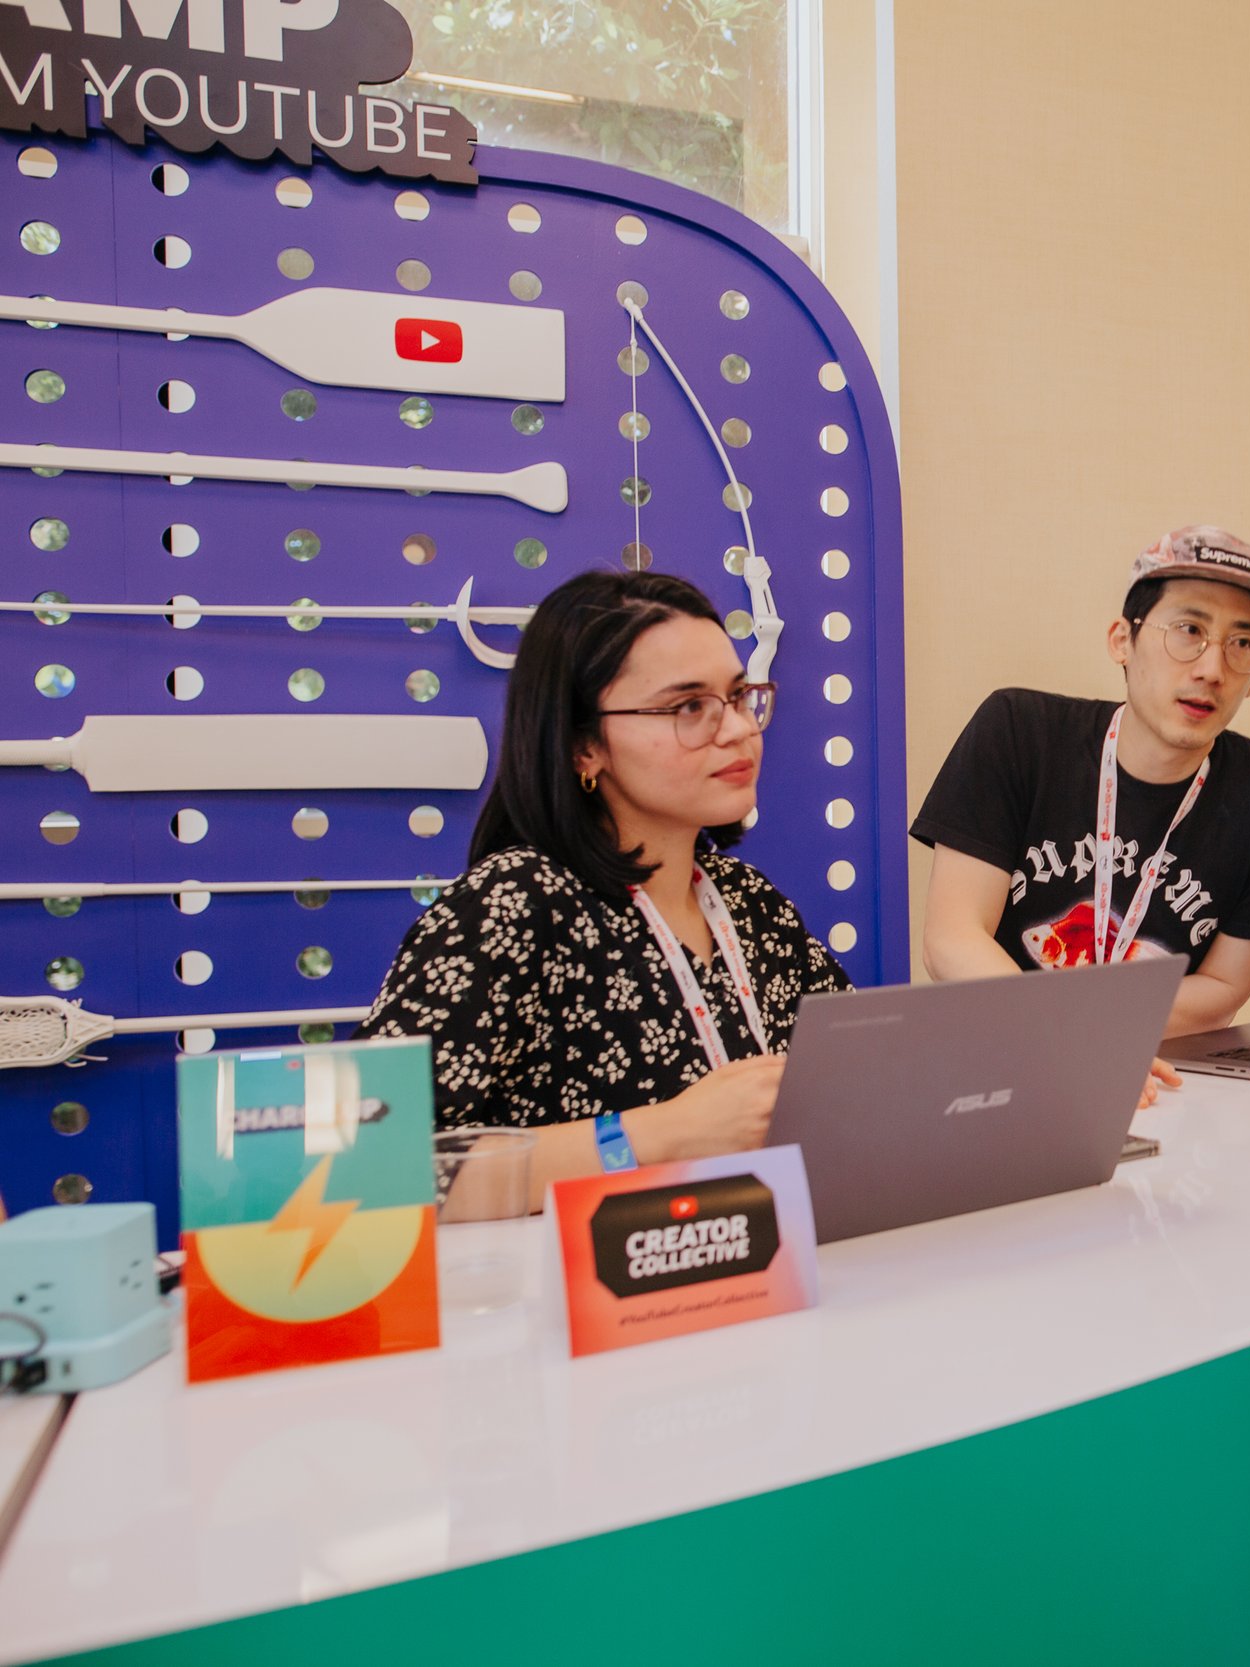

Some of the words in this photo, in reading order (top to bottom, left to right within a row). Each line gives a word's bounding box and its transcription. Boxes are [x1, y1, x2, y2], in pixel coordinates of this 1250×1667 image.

[0, 0, 340, 62] MP
[80, 58, 452, 161] YOUTUBE
[944, 1088, 1013, 1116] ASUS
[625, 1213, 749, 1260] CREATOR
[628, 1237, 751, 1280] COLLECTIVE
